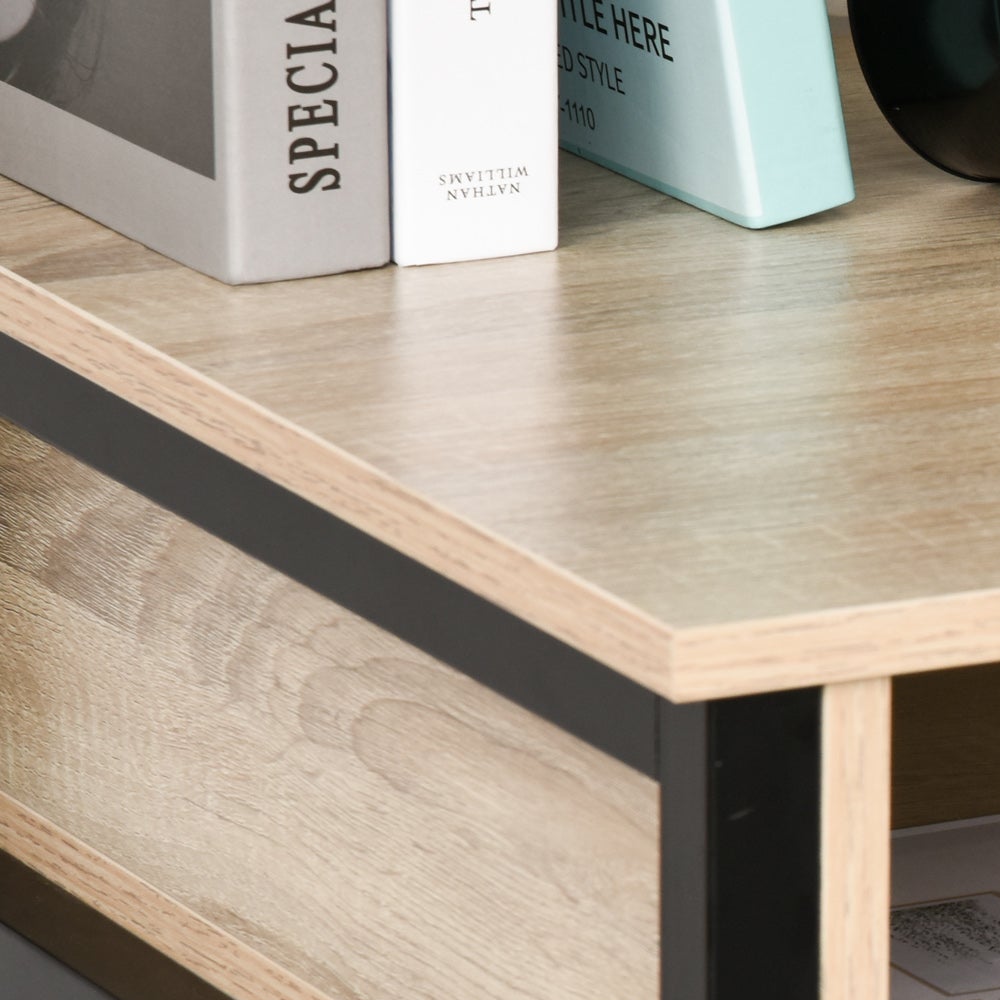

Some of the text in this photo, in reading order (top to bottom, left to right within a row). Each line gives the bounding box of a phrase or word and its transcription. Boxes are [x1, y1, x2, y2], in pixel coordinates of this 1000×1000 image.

[610, 3, 674, 62] HERE
[577, 52, 626, 95] STYLE
[285, 0, 341, 194] SPECIA
[439, 166, 529, 186] WILLIAMS
[446, 182, 521, 200] NATHAN
